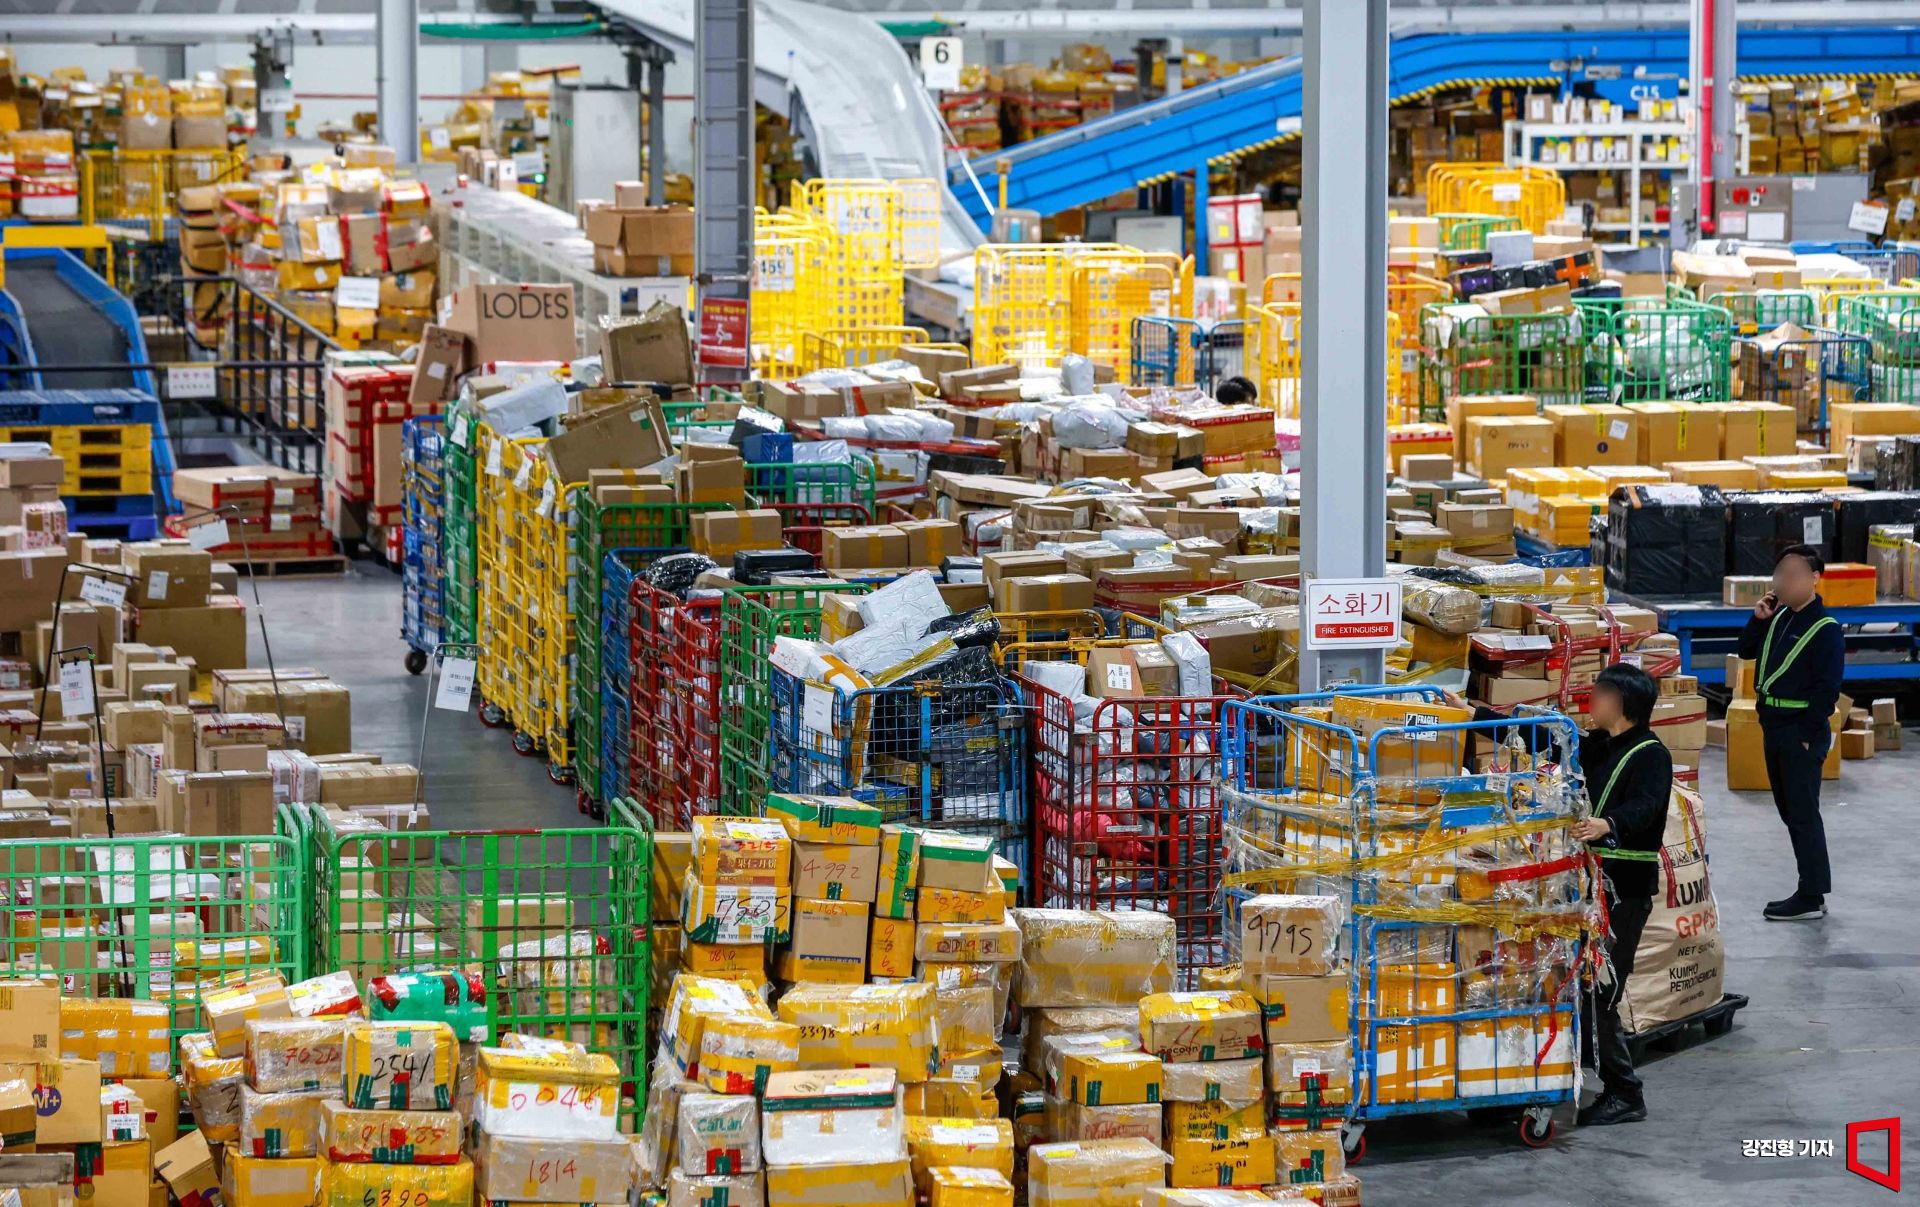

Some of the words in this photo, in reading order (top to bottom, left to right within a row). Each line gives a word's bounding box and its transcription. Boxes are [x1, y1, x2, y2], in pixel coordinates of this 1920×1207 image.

[935, 41, 949, 64] 6
[483, 292, 569, 319] LODES
[1318, 592, 1390, 616] 소화기
[1321, 627, 1337, 635] FIRE
[1339, 625, 1389, 634] EXTINGUISHER
[1417, 714, 1439, 724] FRAGILE
[803, 858, 862, 880] 4992
[717, 895, 788, 927] 7505
[1247, 914, 1312, 956] 9795
[1678, 945, 1696, 957] NET
[1669, 963, 1698, 980] KUMHO
[529, 1160, 577, 1184] 1814
